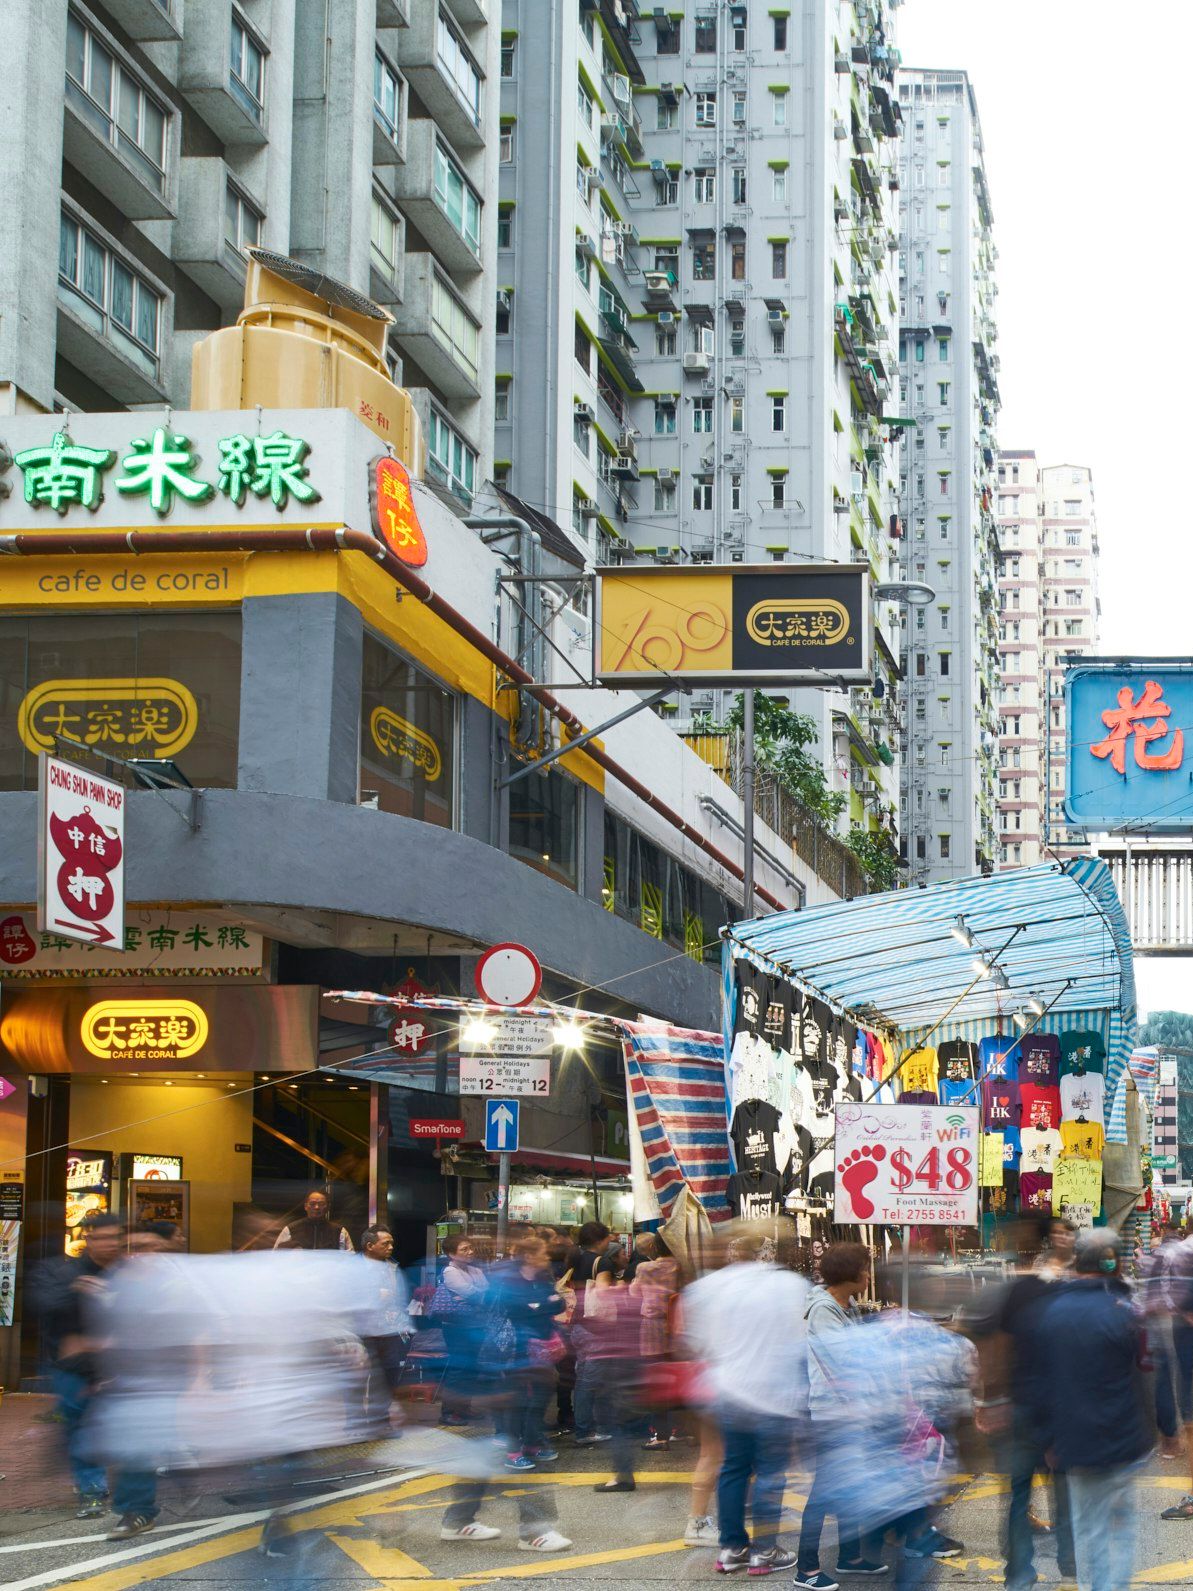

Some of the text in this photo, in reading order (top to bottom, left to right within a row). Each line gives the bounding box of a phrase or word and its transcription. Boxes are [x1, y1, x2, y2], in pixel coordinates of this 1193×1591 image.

[0, 426, 322, 516] 南米線
[382, 468, 418, 547] 譚仔
[39, 567, 229, 592] cafe de coral
[50, 765, 122, 811] CHUNG SHUN PAWN SHOP
[67, 826, 107, 856] 中信
[67, 866, 105, 911] 押
[3, 924, 30, 958] 譚仔
[40, 923, 250, 951] 譚雲南米線
[394, 1019, 425, 1051] 押
[135, 1050, 147, 1058] DE
[148, 1050, 176, 1058] CORAL
[479, 1078, 494, 1090] 12
[532, 1079, 547, 1092] 12
[990, 1107, 1011, 1118] HK
[992, 1096, 998, 1108] I
[414, 1123, 462, 1134] SmarTone
[937, 1126, 971, 1143] WiFi
[890, 1146, 973, 1194] $48
[882, 1208, 966, 1220] Tel: 2755 8541
[896, 1198, 958, 1207] Foot Massage
